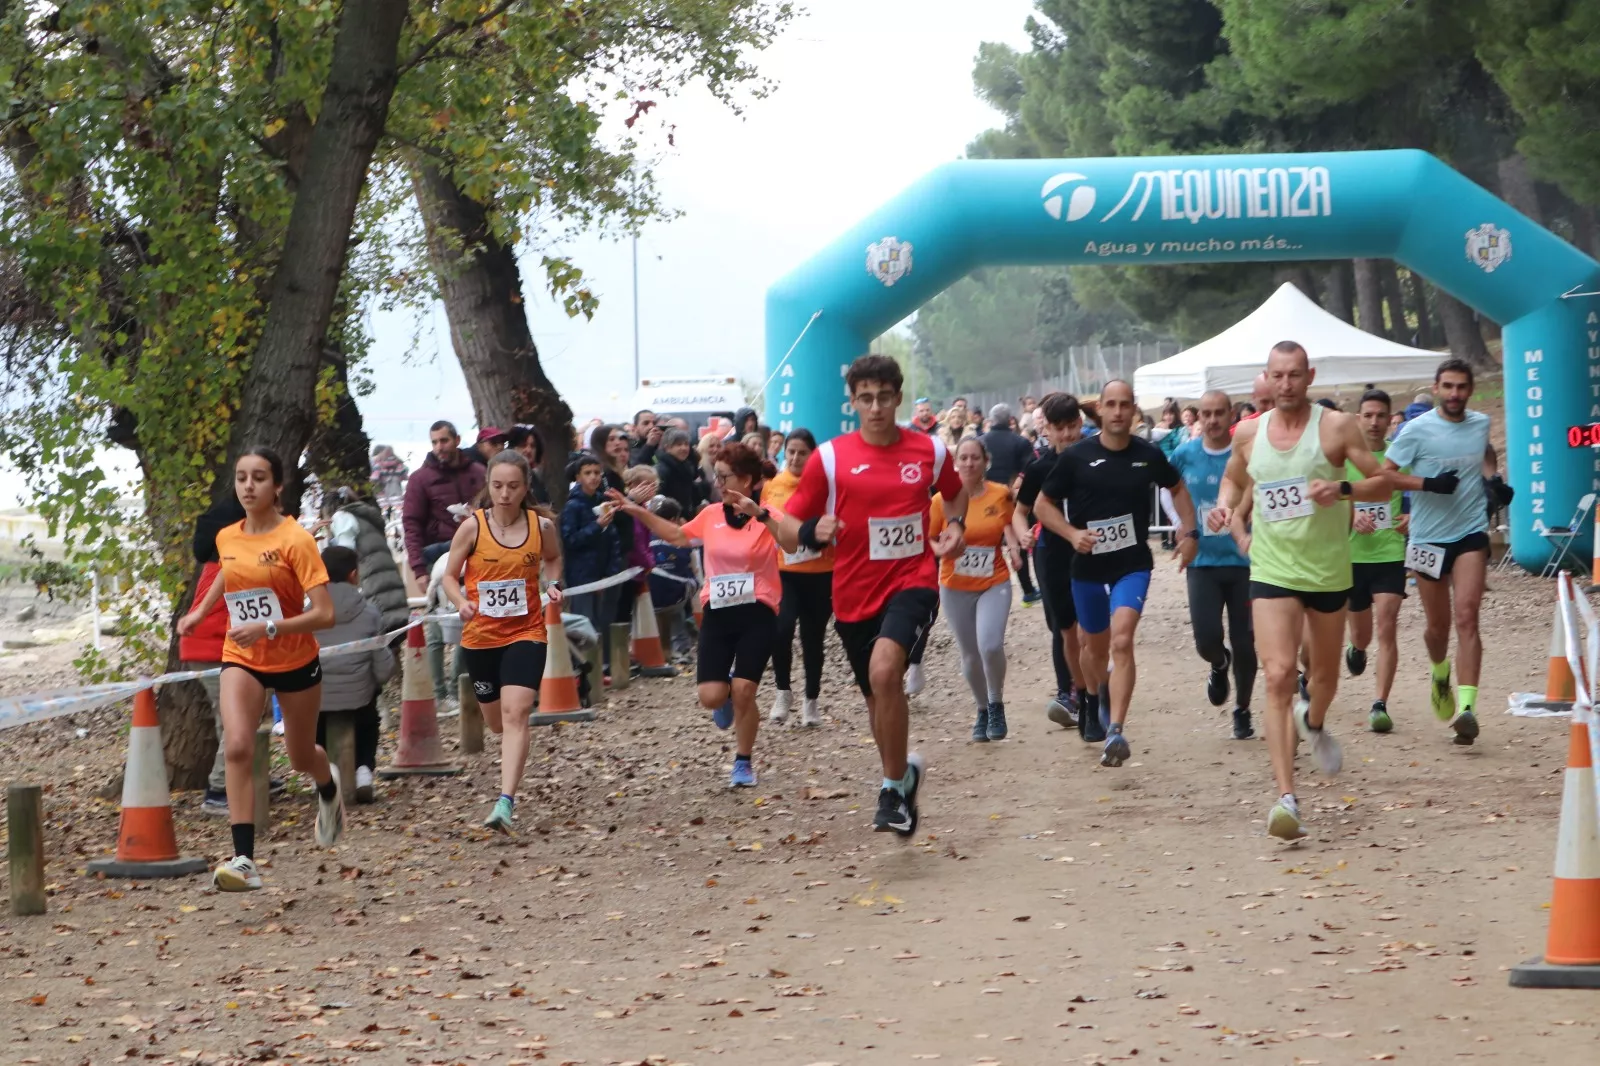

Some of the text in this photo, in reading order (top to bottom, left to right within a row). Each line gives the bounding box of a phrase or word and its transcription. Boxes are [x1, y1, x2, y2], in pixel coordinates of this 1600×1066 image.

[1100, 166, 1331, 224] MEQUINENZA
[1084, 240, 1137, 256] Agua
[1142, 242, 1156, 255] y
[1161, 238, 1235, 252] mucho
[652, 395, 726, 405] AMBULANCIA
[1524, 349, 1546, 532] MEQUINENZA
[1265, 485, 1302, 510] 333
[879, 524, 915, 547] 328
[1096, 523, 1128, 543] 336
[960, 552, 989, 569] 337
[1412, 546, 1437, 568] 359
[486, 587, 520, 607] 354
[716, 580, 747, 598] 357
[235, 595, 272, 621] 355
